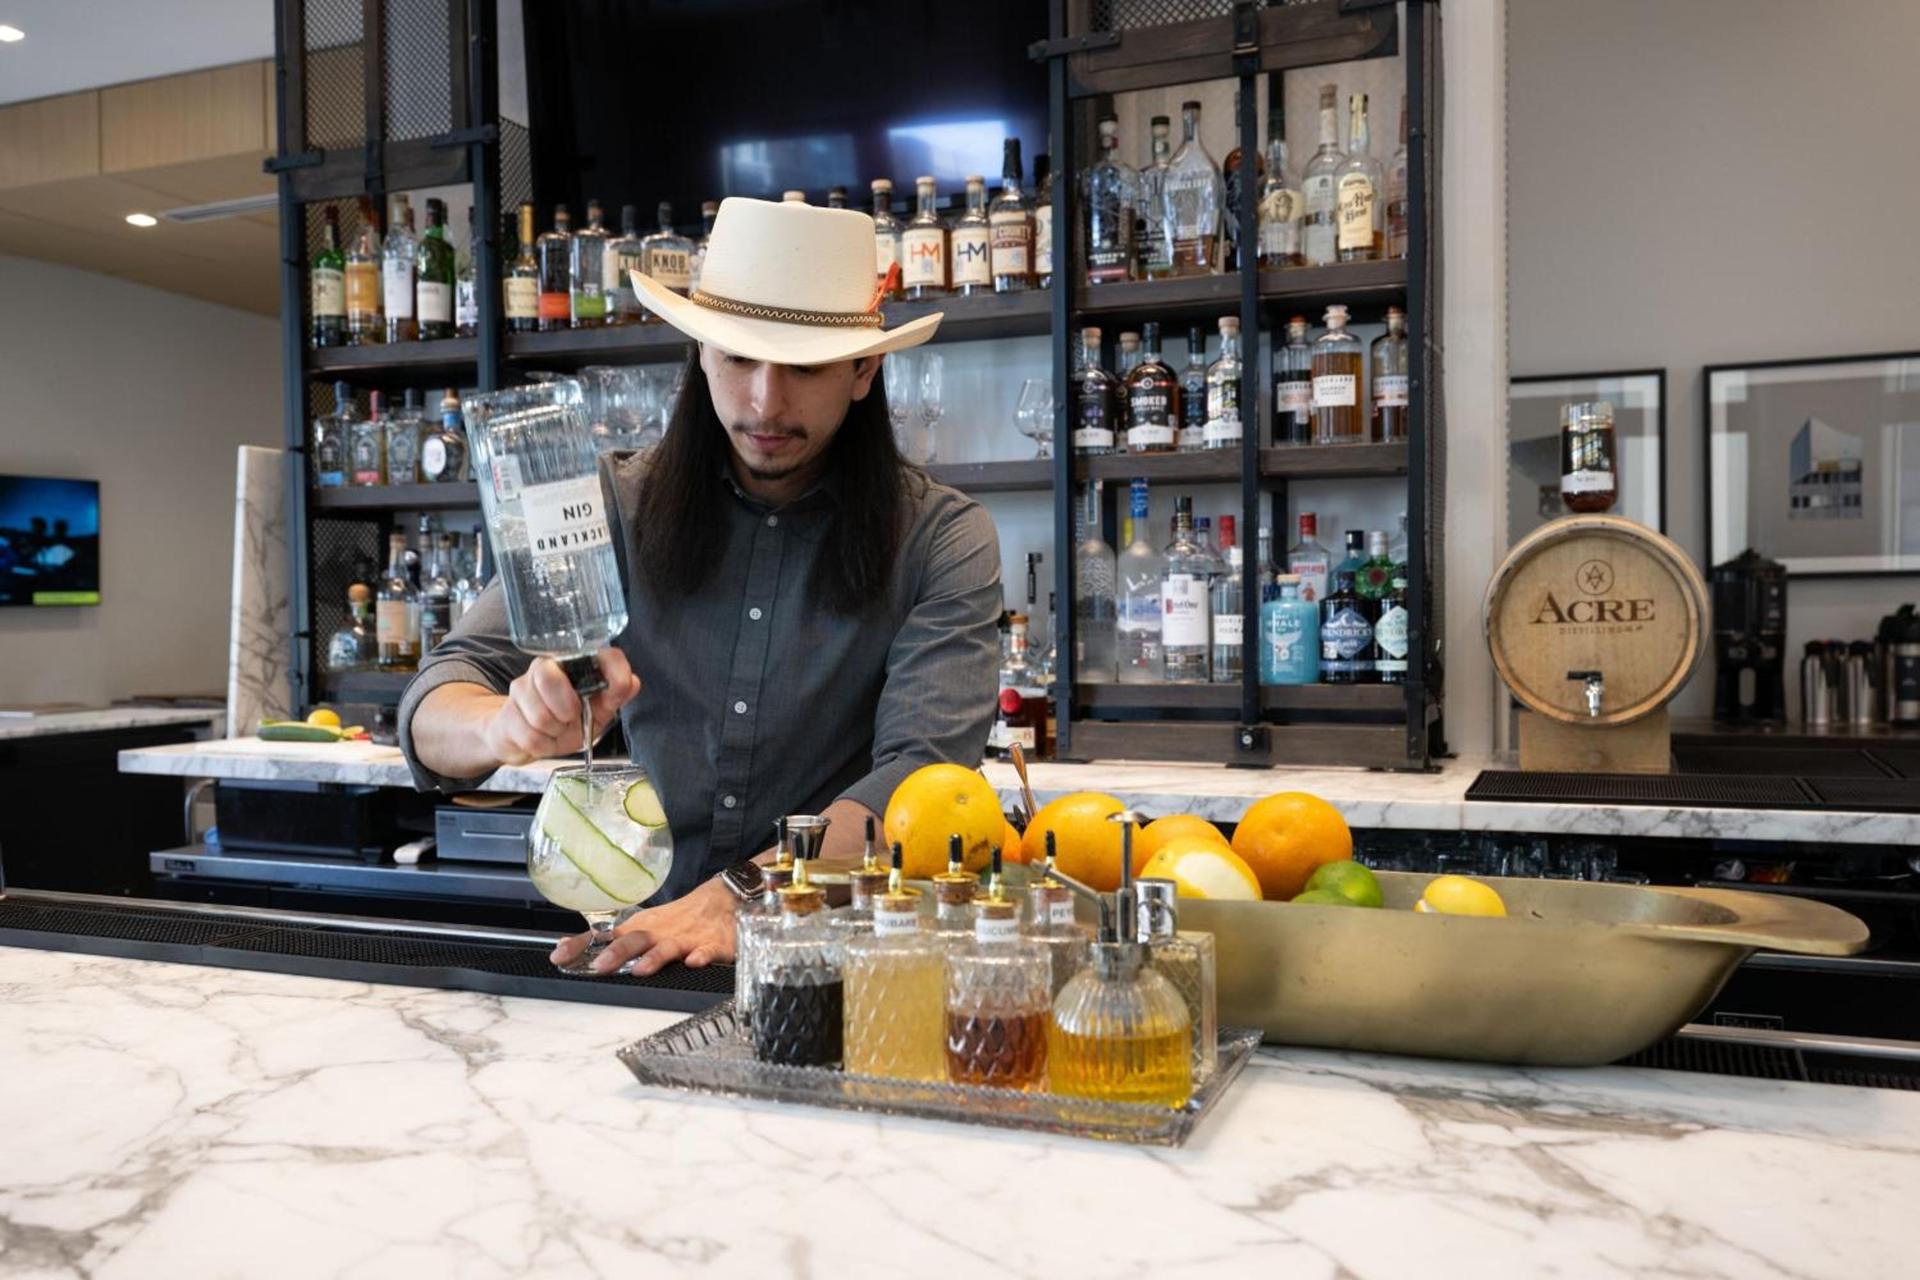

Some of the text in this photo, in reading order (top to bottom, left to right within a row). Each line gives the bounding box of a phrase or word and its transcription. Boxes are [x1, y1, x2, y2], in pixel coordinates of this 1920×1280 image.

[653, 254, 686, 269] KNOB
[911, 243, 941, 264] HM
[957, 242, 987, 263] HM
[1130, 395, 1167, 407] SMOKED
[562, 502, 592, 521] GIN
[1528, 590, 1656, 624] ACRE
